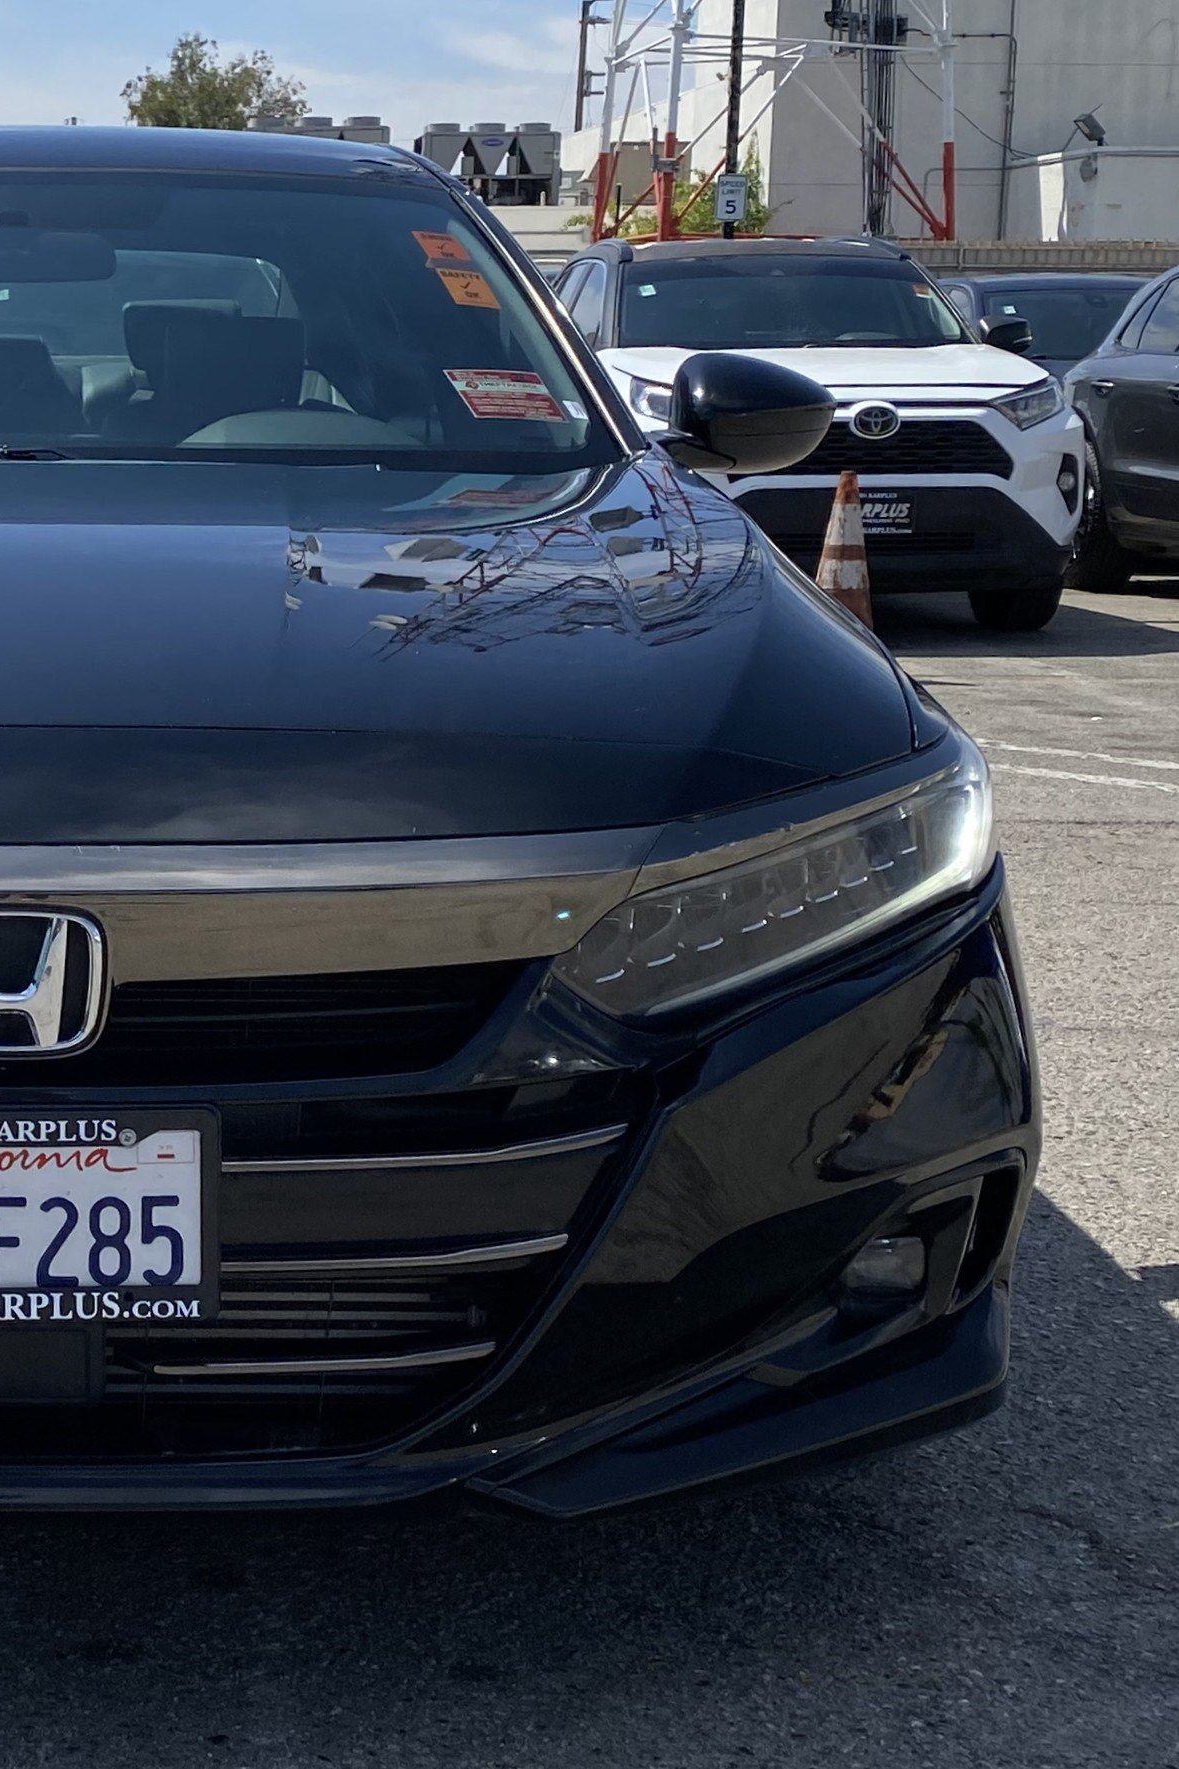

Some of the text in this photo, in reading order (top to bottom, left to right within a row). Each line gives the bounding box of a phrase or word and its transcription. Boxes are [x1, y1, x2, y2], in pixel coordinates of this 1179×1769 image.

[721, 180, 745, 188] SPEED
[725, 199, 737, 214] 5
[439, 270, 481, 280] SAFETY
[861, 503, 910, 518] RPLUS
